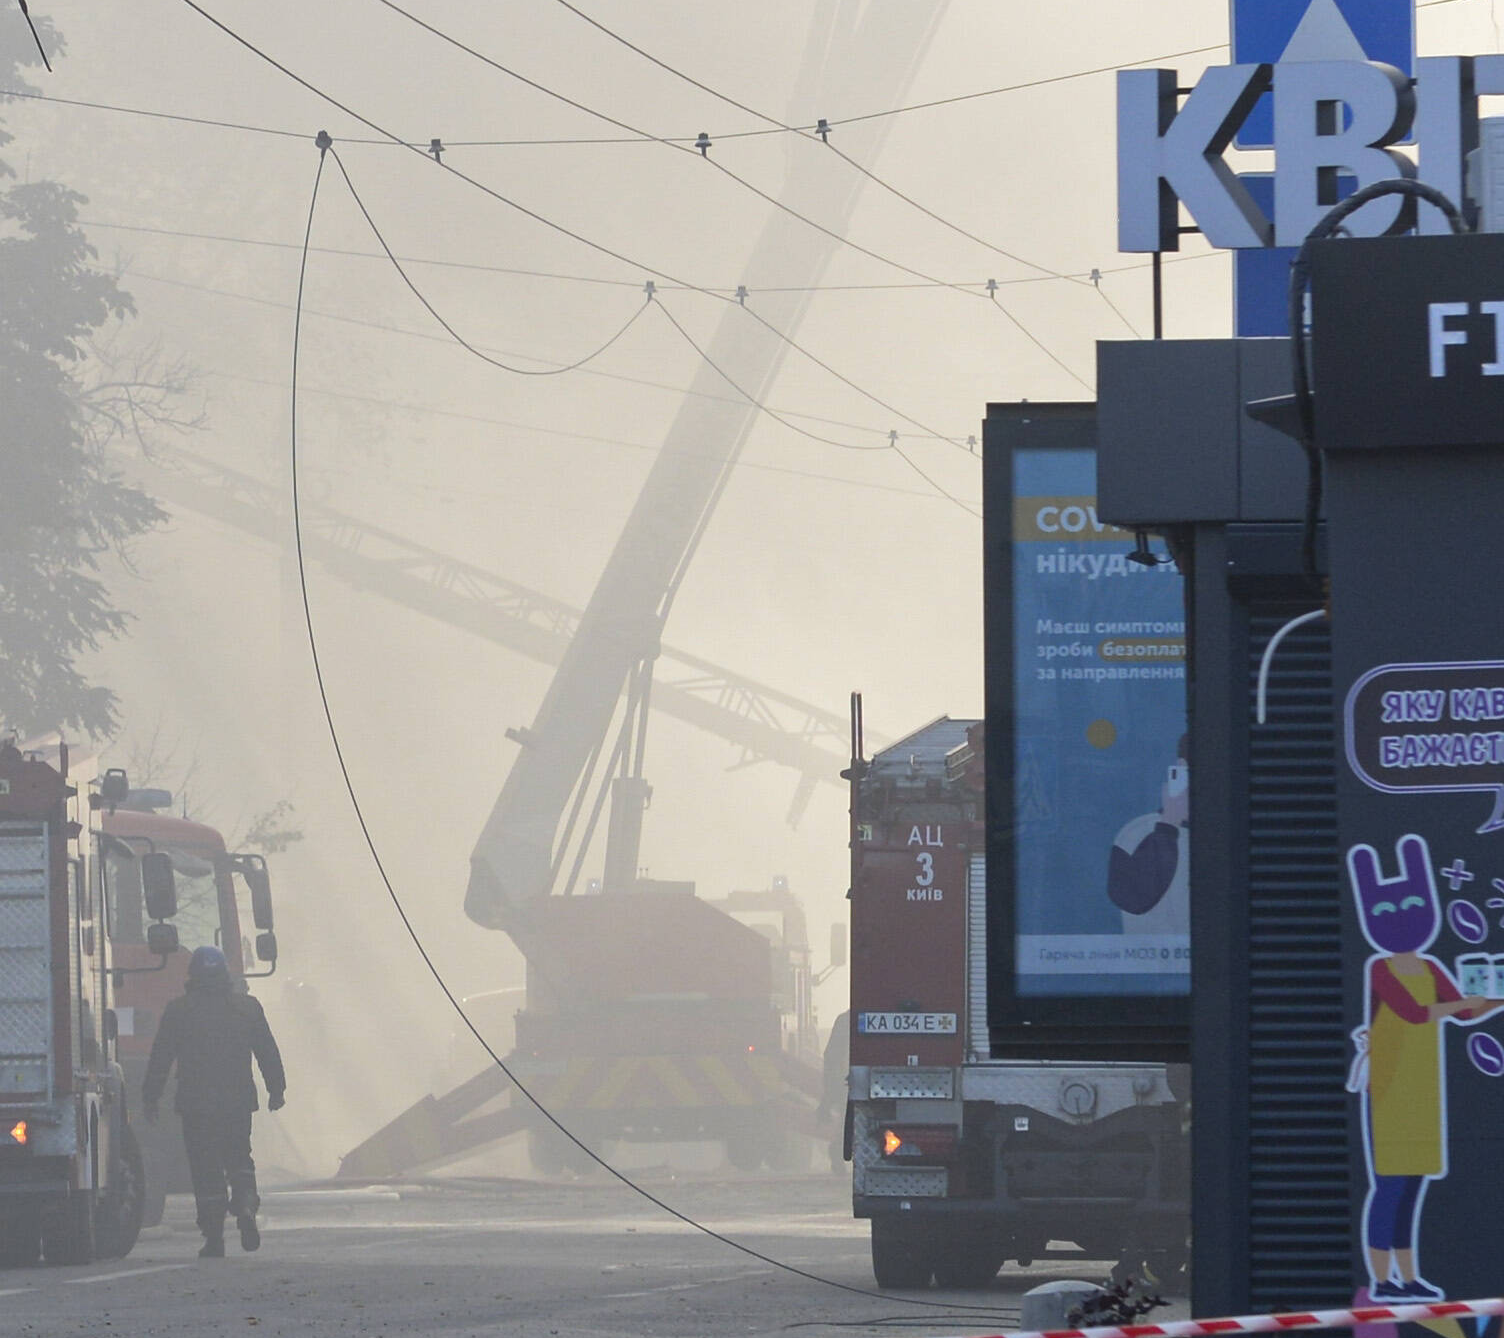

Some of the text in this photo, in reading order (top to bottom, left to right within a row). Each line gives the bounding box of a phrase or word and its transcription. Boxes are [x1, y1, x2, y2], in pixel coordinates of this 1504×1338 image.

[1036, 619, 1090, 635] Маєш
[1036, 641, 1093, 660] зроби
[1037, 667, 1056, 680] за
[1381, 690, 1445, 723] ЯКУ
[907, 825, 944, 847] АЦ
[916, 852, 934, 887] 3
[1124, 947, 1156, 959] МОЗ
[1160, 947, 1170, 959] 0
[893, 1016, 920, 1031] 034
